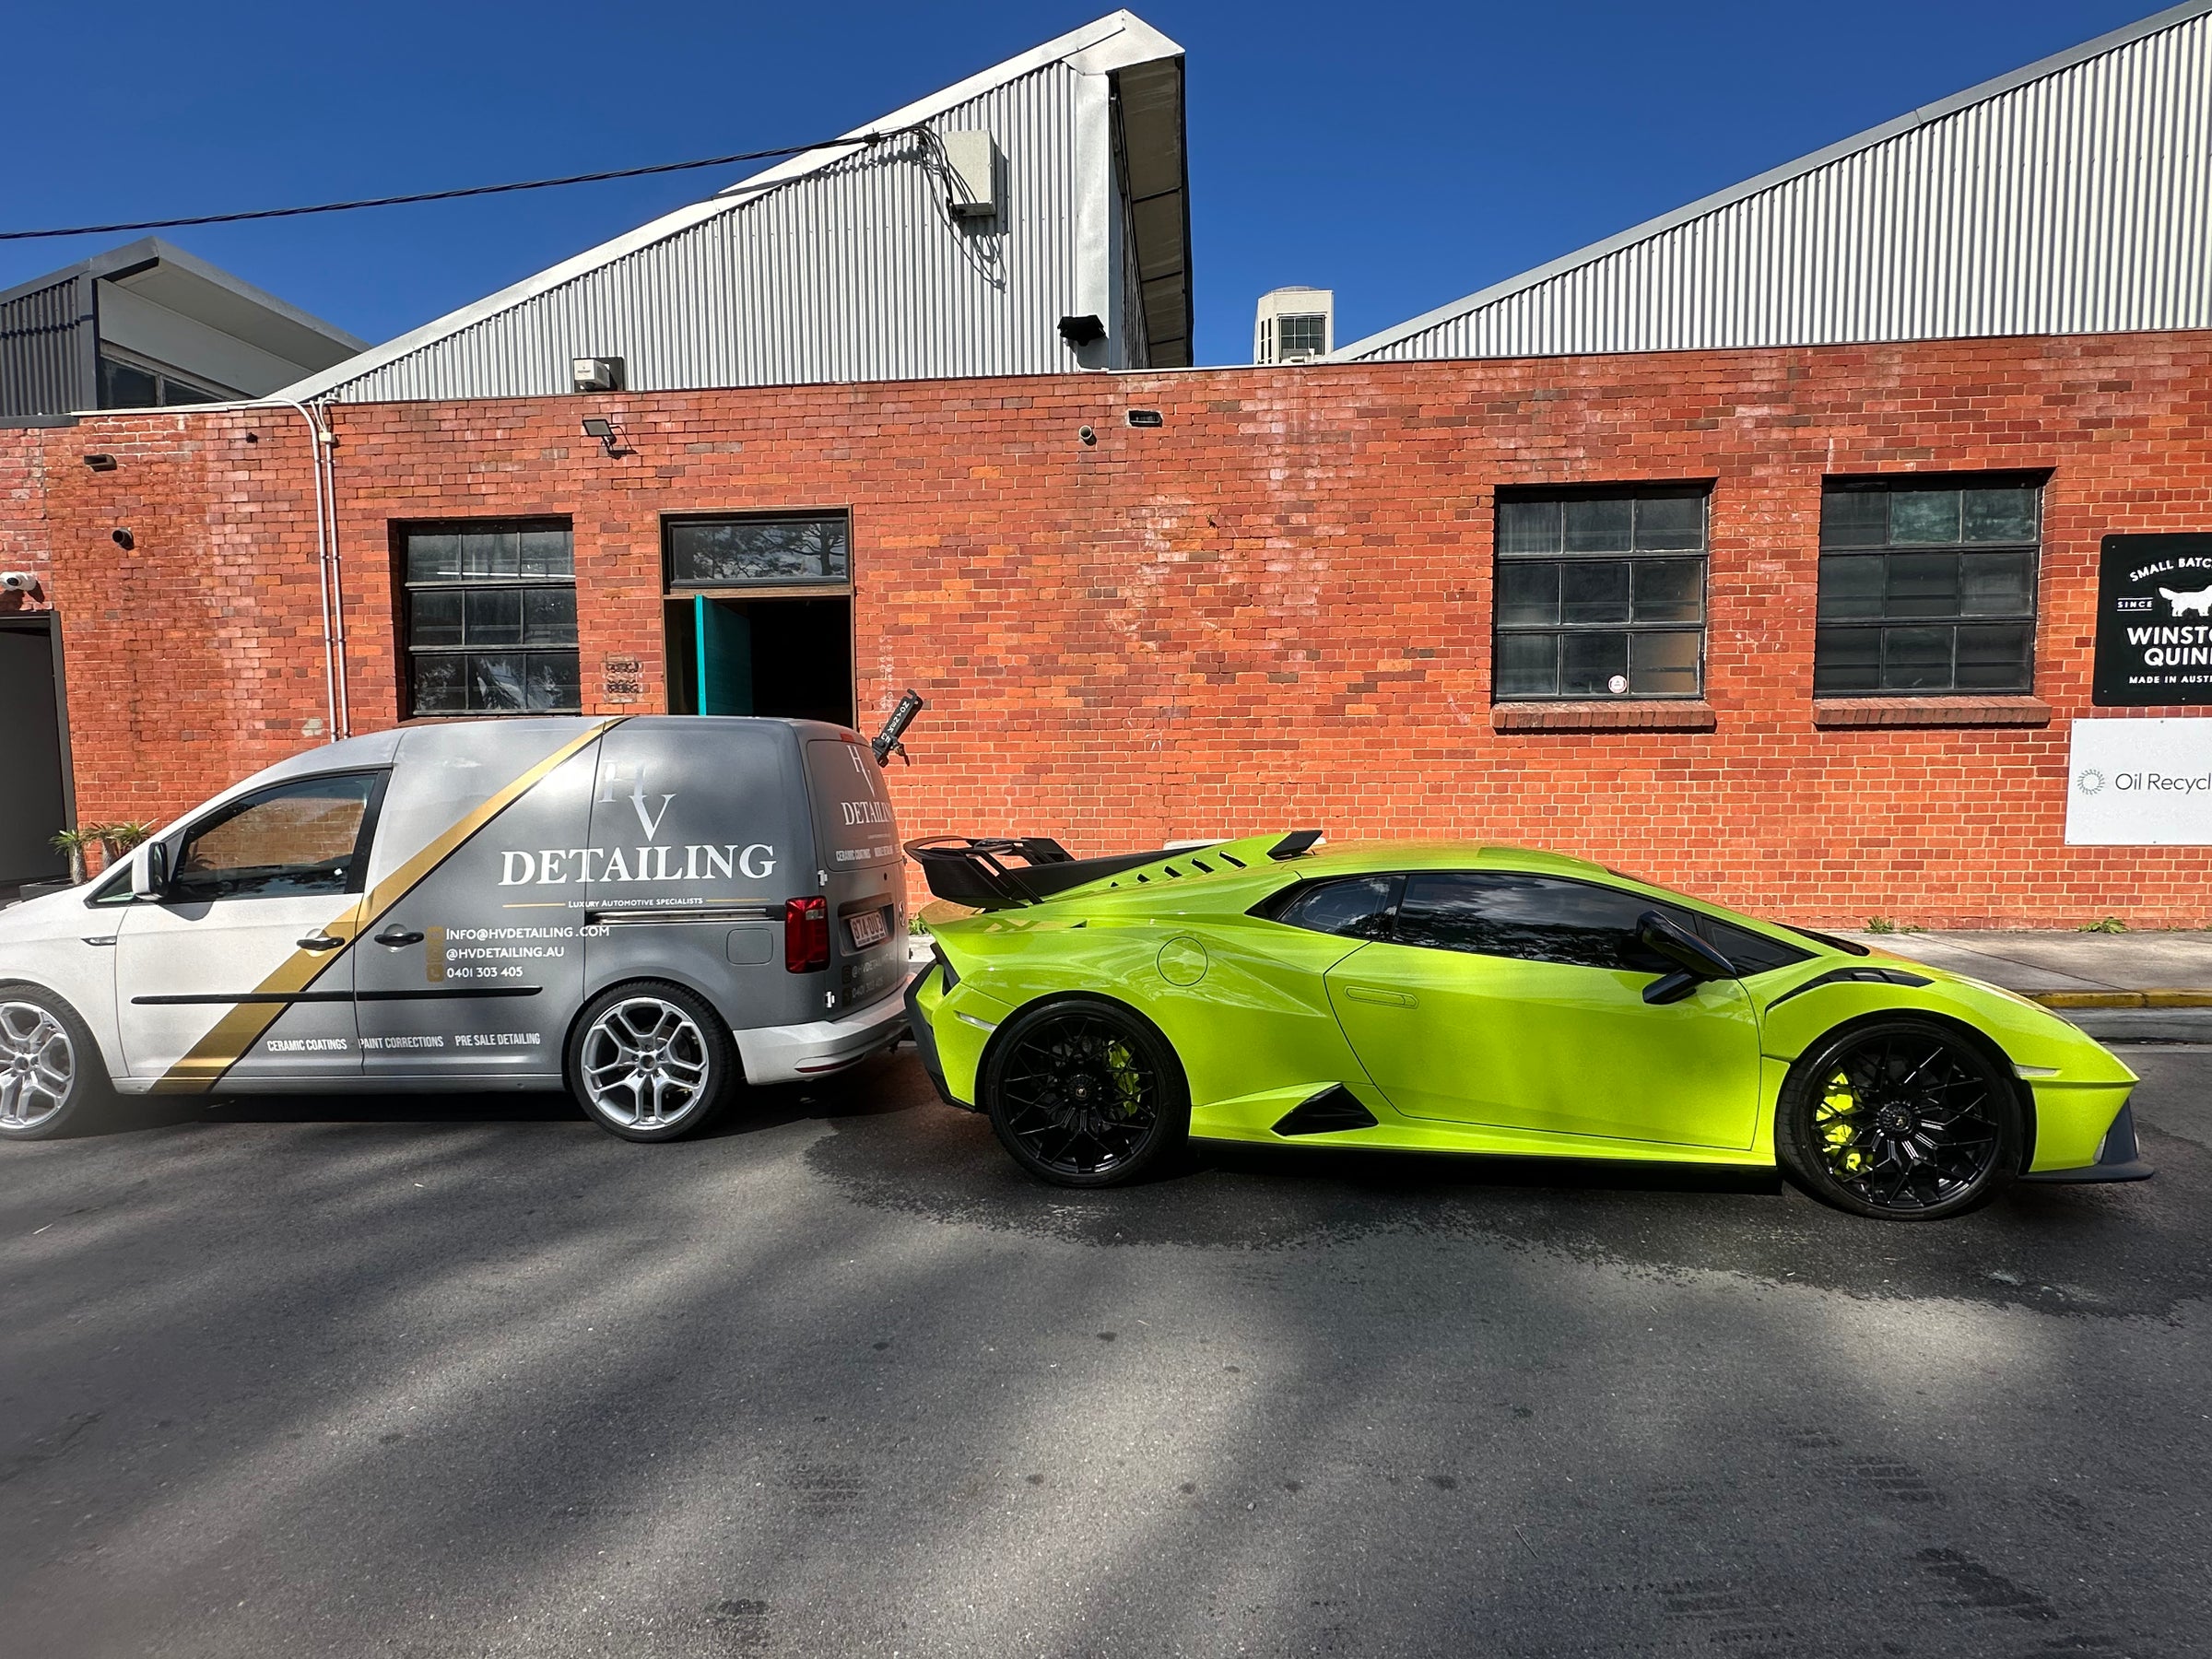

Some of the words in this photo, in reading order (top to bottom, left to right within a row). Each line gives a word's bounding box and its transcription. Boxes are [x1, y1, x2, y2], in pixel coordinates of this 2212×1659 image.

[2129, 559, 2174, 582] SMALL
[2178, 557, 2212, 569] BATC
[2117, 600, 2153, 608] SINCE
[2127, 626, 2212, 645] WINST
[2144, 647, 2212, 667] QUIN
[2129, 676, 2160, 684] MADE
[2164, 675, 2177, 684] IN
[2115, 772, 2142, 791] Oil
[498, 843, 778, 887] DETAILING
[568, 900, 600, 909] LUXURY
[601, 899, 654, 908] AUTOMOTIVE
[655, 897, 703, 906] SPECIALISTS
[446, 947, 565, 961] @HVDETAILING.AU
[446, 968, 473, 979] 0401
[476, 967, 498, 978] 303
[500, 966, 524, 977] 405
[266, 1039, 305, 1052] CERAMIC
[305, 1038, 347, 1051] COATINGS
[358, 1037, 383, 1049] PAINT
[384, 1035, 444, 1049] CORRECTIONS
[454, 1034, 473, 1047] PRE
[474, 1034, 497, 1046] SALE
[497, 1032, 541, 1045] DETAILING
